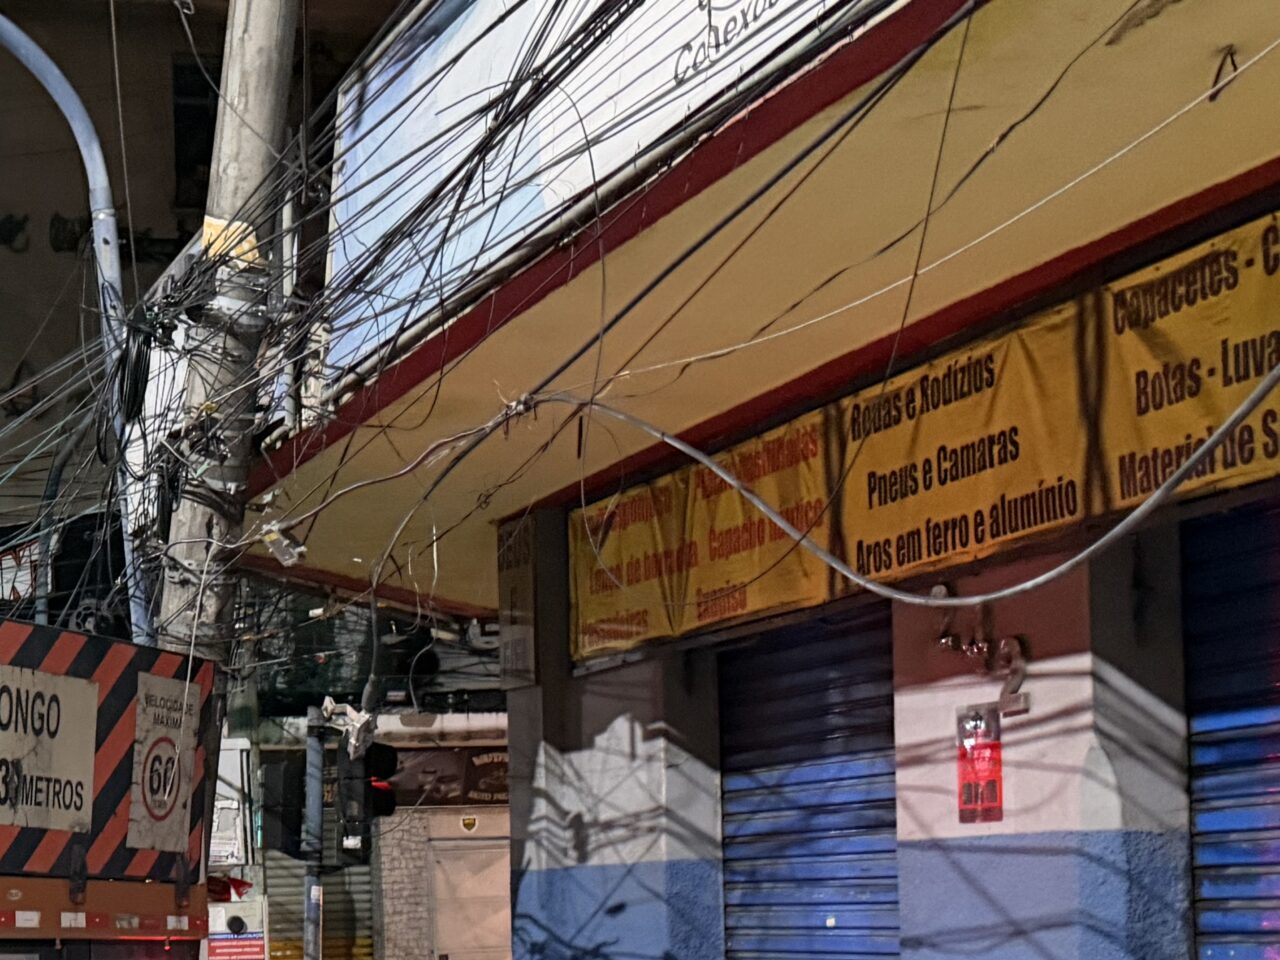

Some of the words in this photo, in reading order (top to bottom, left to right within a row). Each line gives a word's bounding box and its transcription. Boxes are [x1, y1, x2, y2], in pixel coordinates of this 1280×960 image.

[905, 385, 917, 421] e
[920, 352, 996, 416] Rodízios
[1135, 357, 1201, 417] Botas
[867, 461, 919, 510] Pneus
[922, 457, 933, 491] e
[937, 426, 1019, 487] Camaras
[856, 537, 893, 577] Aros
[896, 527, 923, 567] em
[926, 513, 970, 558] ferro
[974, 508, 986, 544] e
[989, 475, 1077, 540] alumínio
[21, 773, 84, 811] METROS
[149, 754, 177, 798] 60
